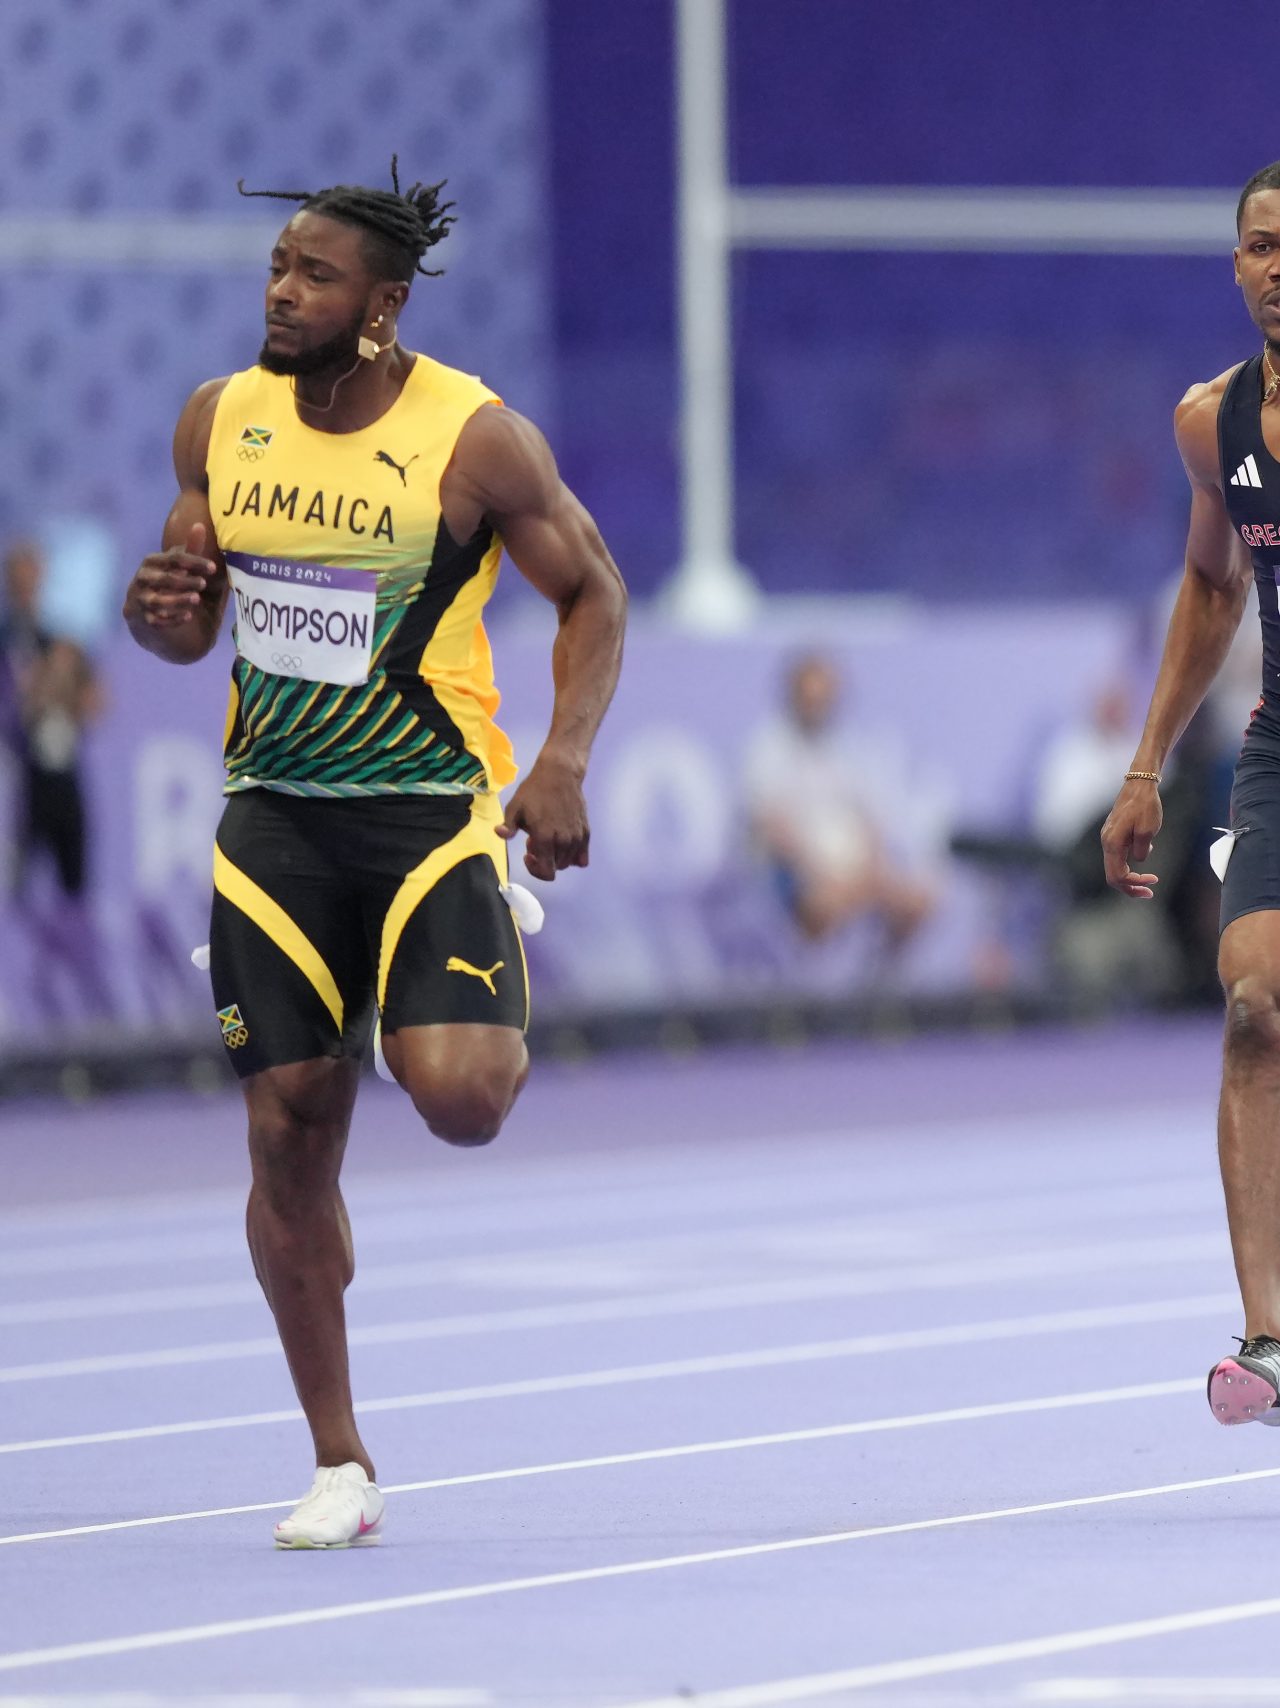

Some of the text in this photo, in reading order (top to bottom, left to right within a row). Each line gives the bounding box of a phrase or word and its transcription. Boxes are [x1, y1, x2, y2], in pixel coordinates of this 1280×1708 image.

[222, 480, 394, 544] JAMAICA
[252, 560, 332, 583] PARIS 2024
[235, 587, 368, 649] THOMPSON
